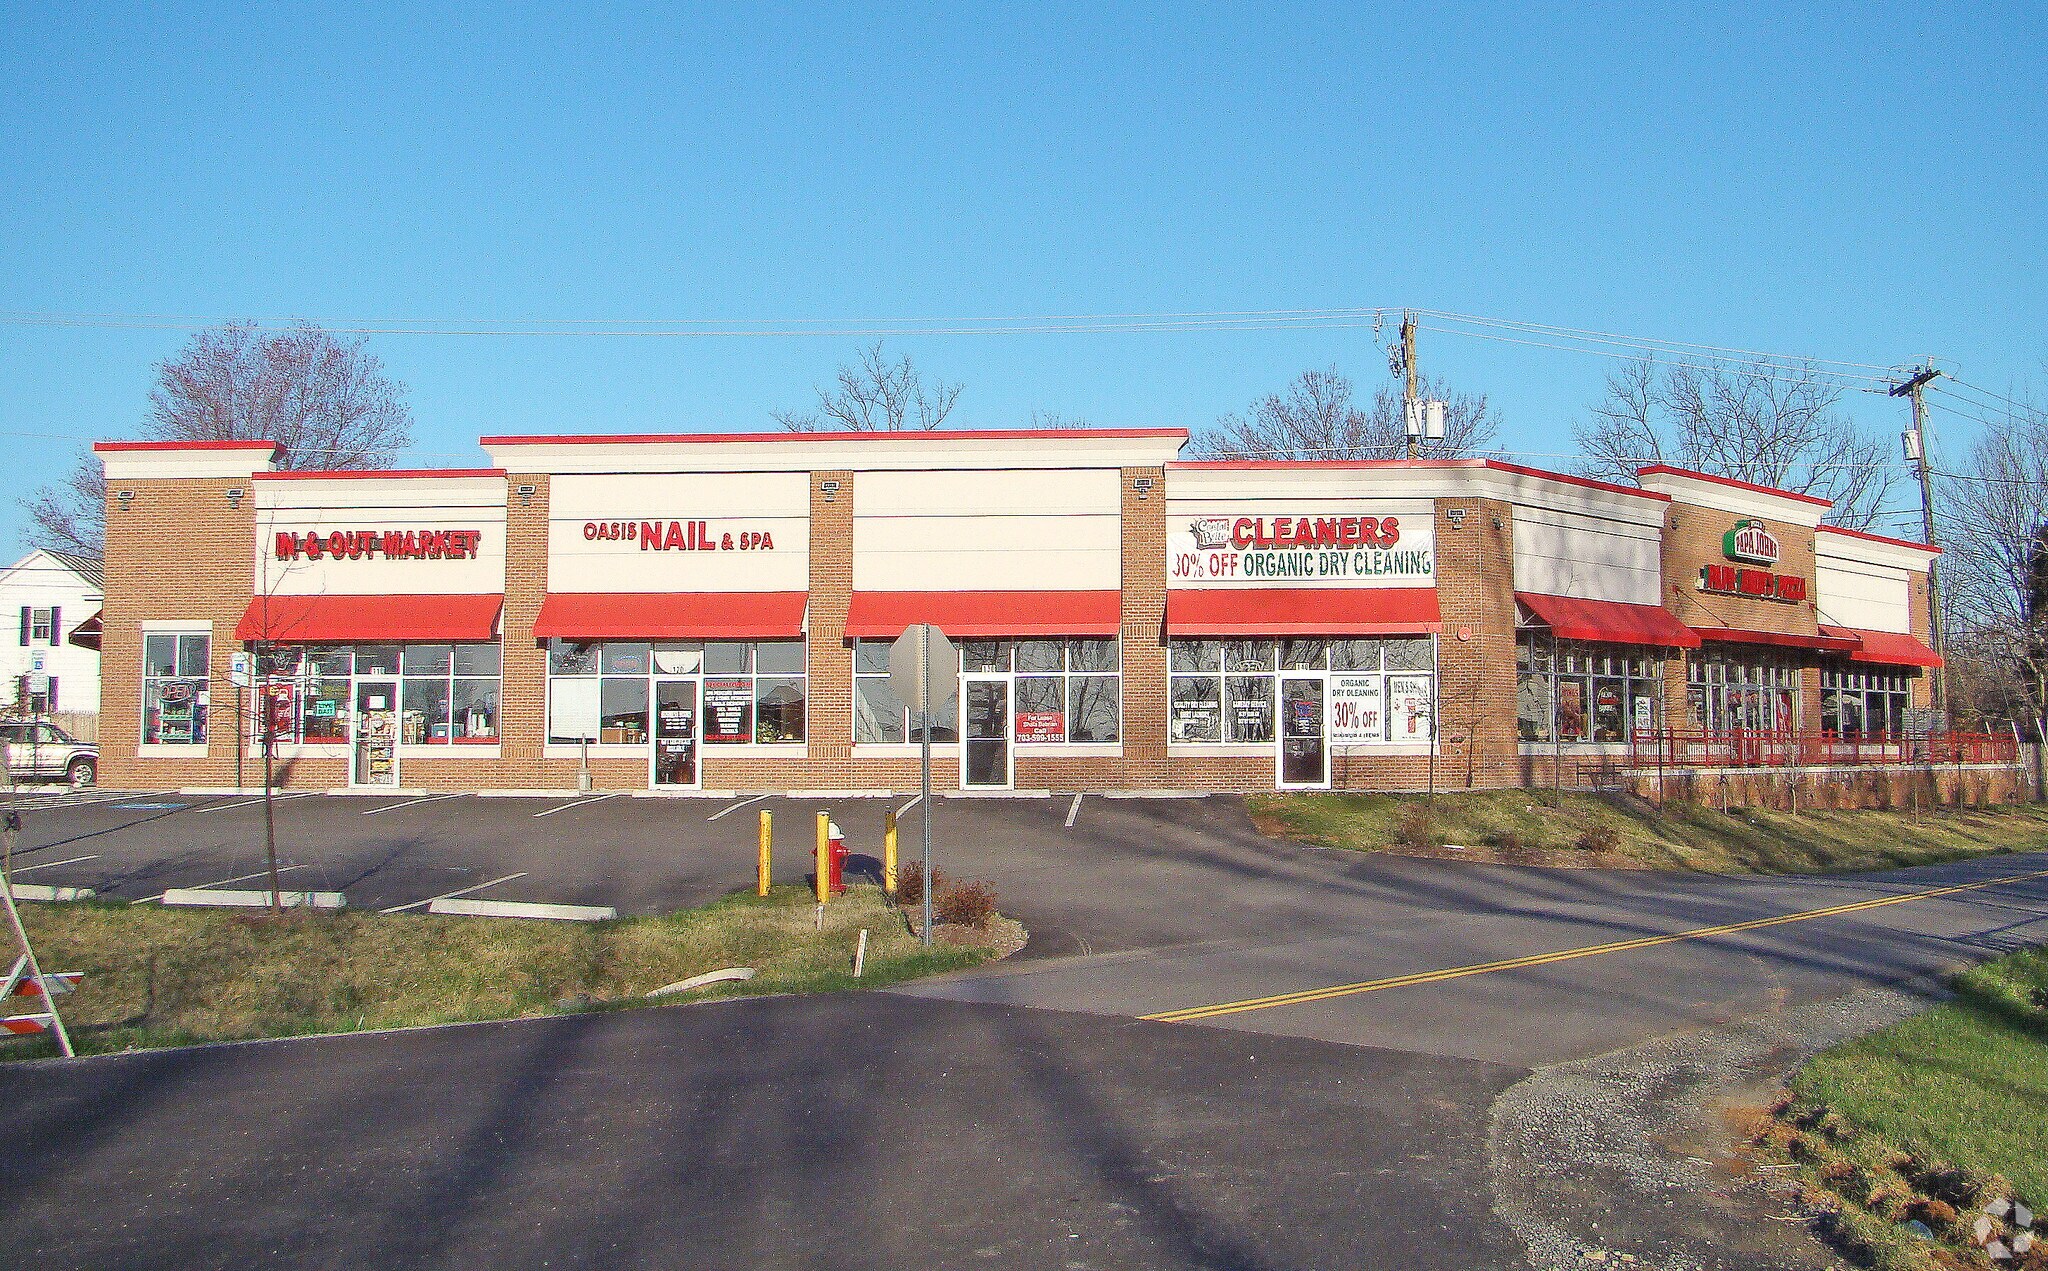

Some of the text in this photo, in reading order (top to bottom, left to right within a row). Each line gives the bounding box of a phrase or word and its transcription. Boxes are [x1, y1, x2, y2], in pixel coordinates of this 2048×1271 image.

[275, 530, 481, 560] IN & OUT MARKET
[583, 521, 774, 550] OASIS NAIL & SPA
[1232, 517, 1400, 549] CLEANERS
[1172, 550, 1432, 578] 30% OFF ORGANIC DRY CLEANING
[1332, 689, 1344, 697] DRY
[1334, 702, 1359, 729] 30%
[1362, 711, 1378, 728] OFF
